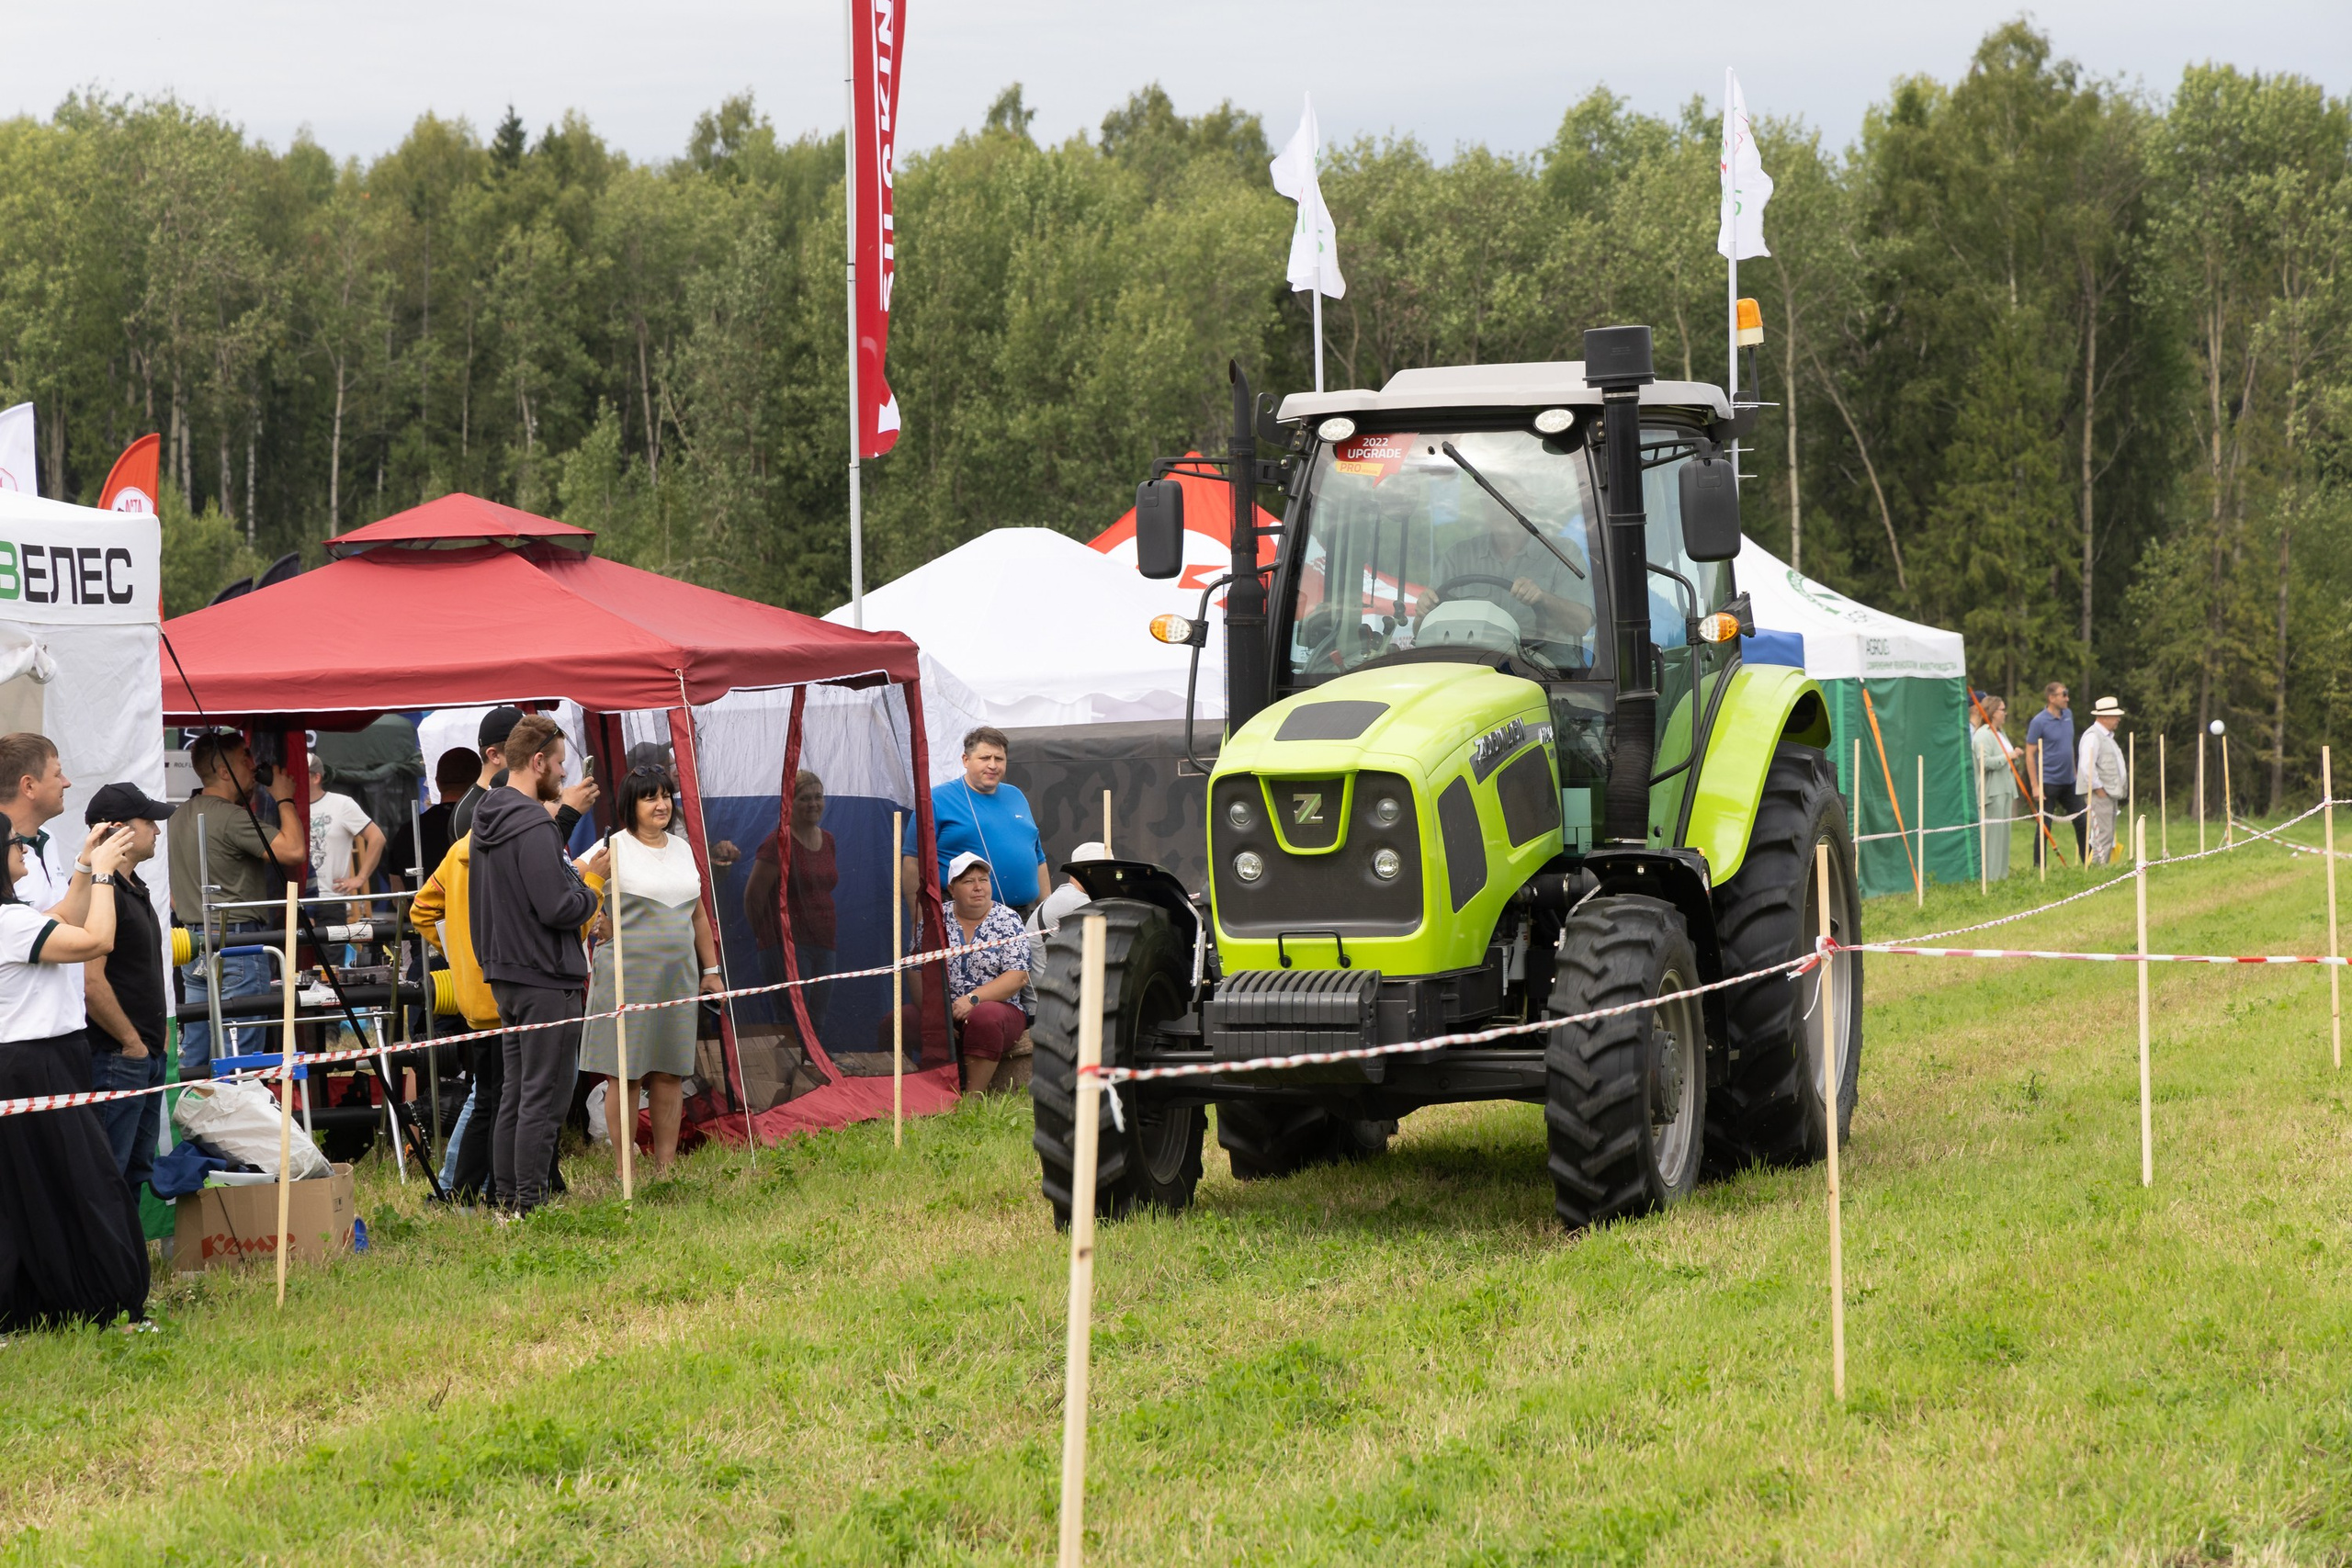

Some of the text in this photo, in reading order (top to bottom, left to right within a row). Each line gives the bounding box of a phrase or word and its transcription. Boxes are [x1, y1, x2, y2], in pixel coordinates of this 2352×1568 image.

[1362, 437, 1389, 446] 2022
[1347, 448, 1402, 458] UPGRADE
[1340, 462, 1362, 473] PRO
